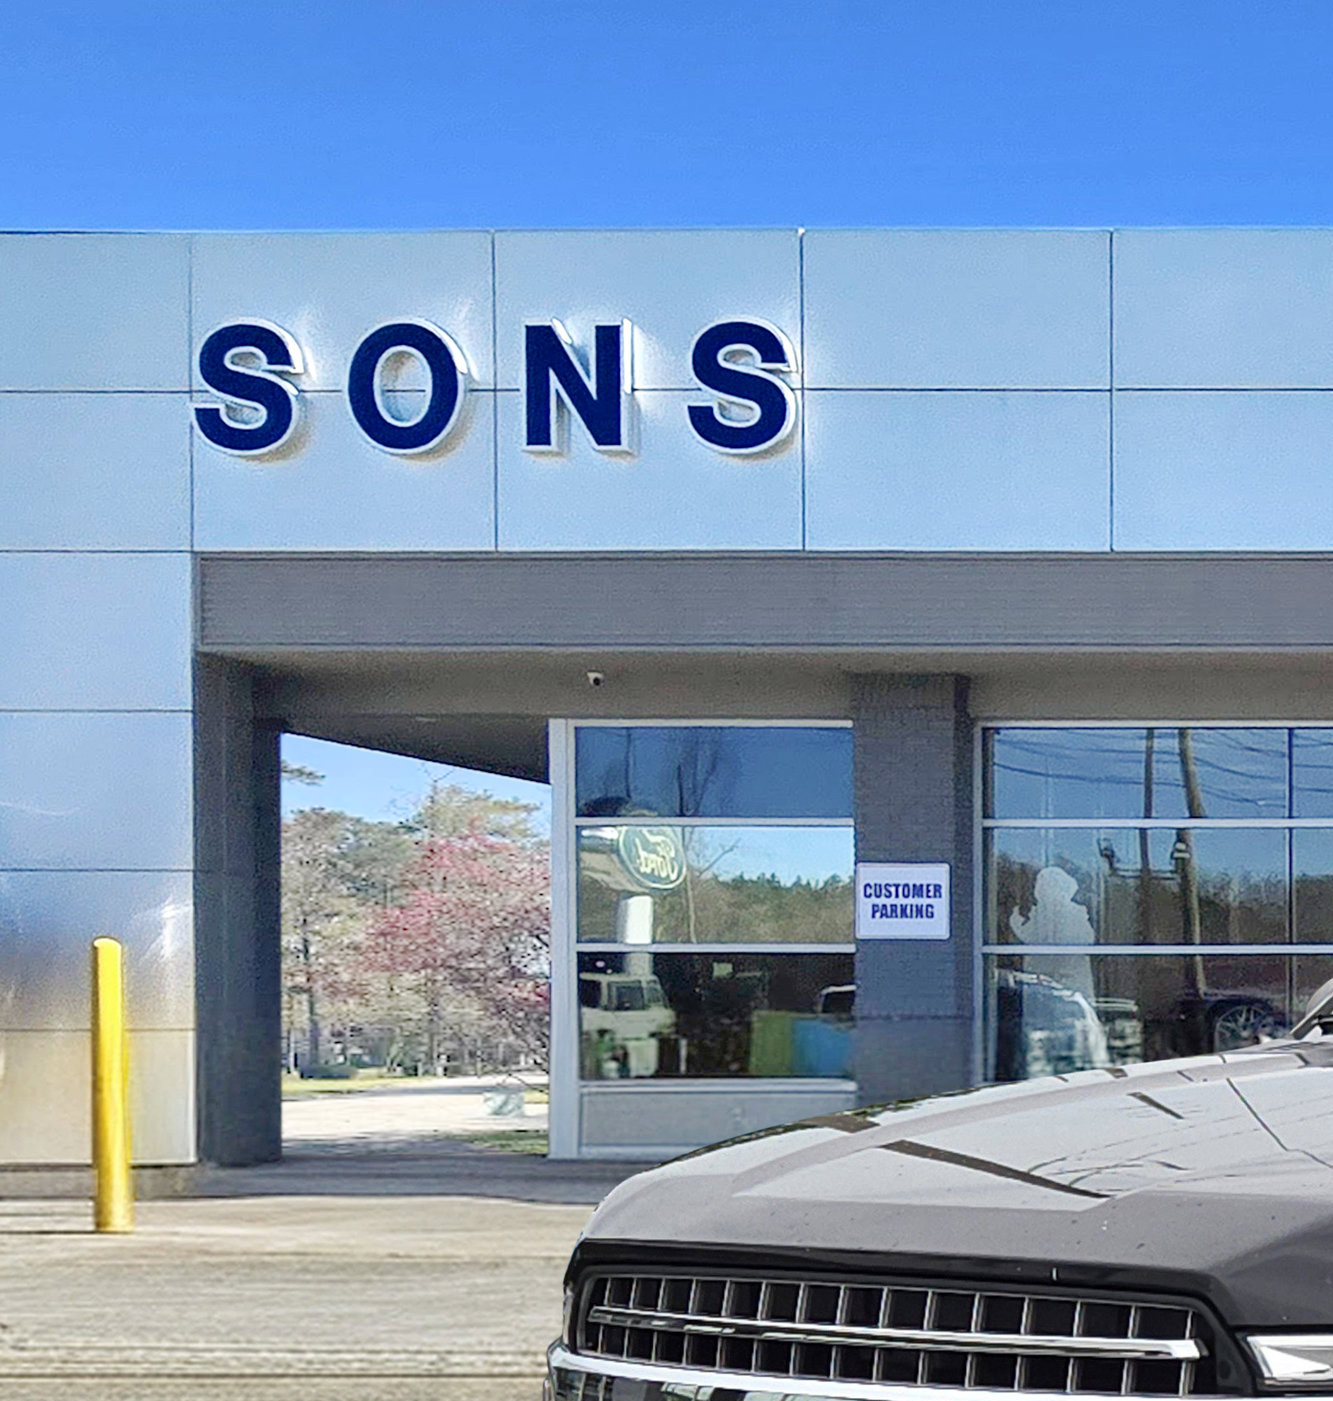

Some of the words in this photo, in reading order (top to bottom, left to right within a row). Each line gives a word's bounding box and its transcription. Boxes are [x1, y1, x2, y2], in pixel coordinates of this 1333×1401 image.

[194, 321, 795, 451] SONS
[863, 882, 943, 899] CUSTOMER
[871, 903, 935, 919] PARKING
